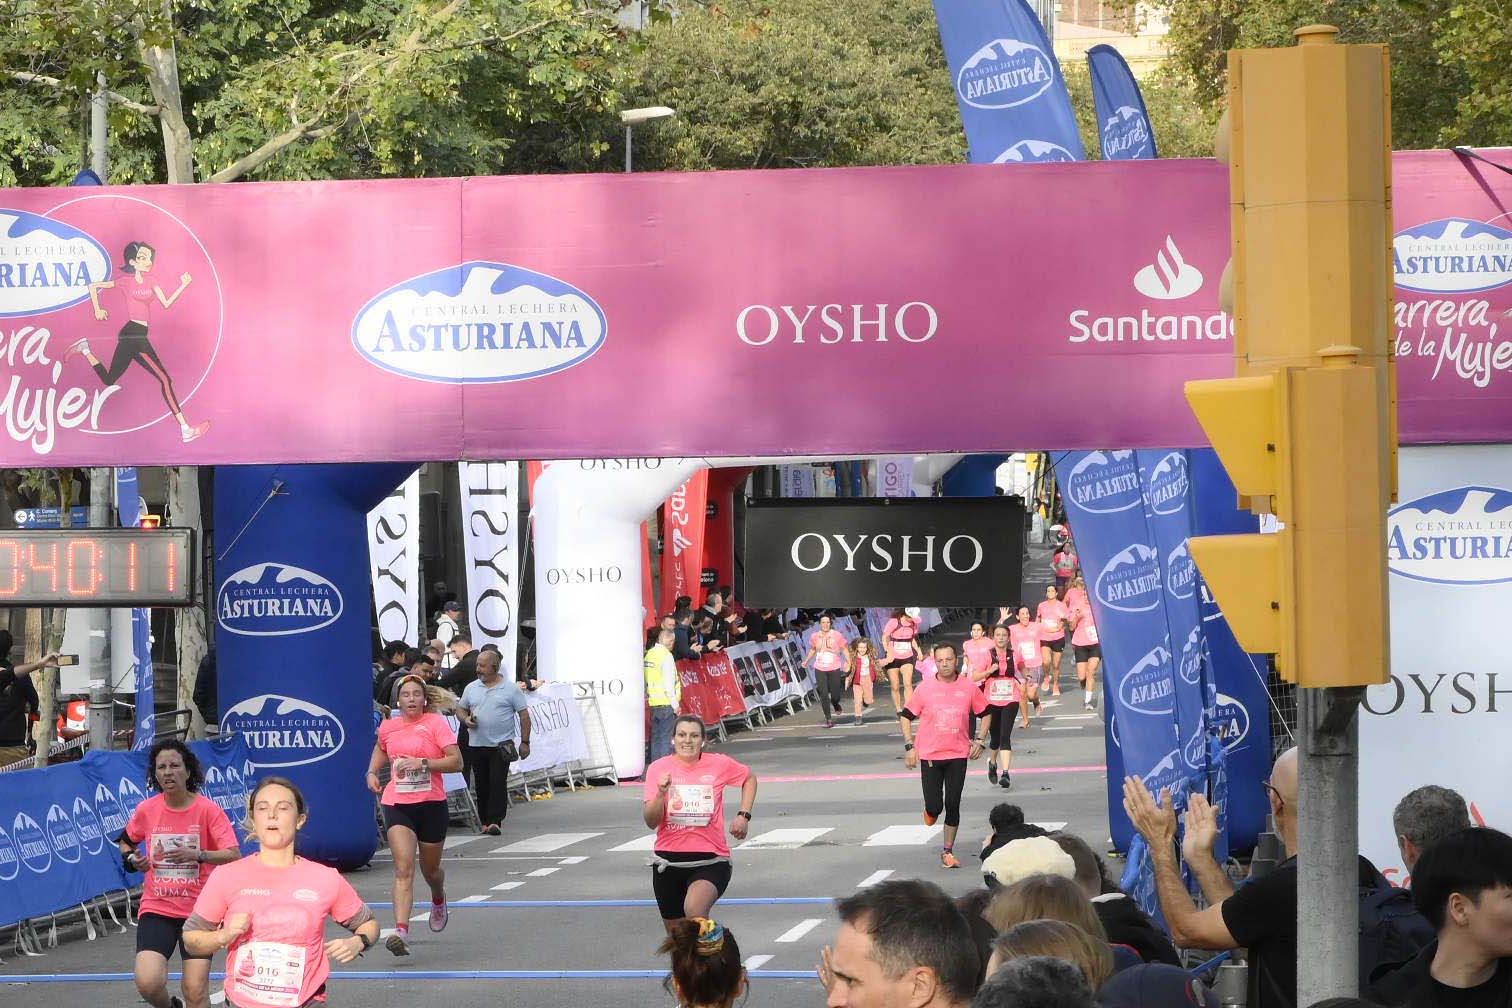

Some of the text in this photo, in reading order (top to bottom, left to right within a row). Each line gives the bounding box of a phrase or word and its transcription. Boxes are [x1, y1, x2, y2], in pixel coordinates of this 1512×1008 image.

[14, 245, 86, 256] LECHERA
[410, 302, 579, 317] CENTRAL LECHERA
[1393, 299, 1490, 328] arrera
[372, 309, 588, 353] ASTURIANA
[736, 301, 939, 346] OYSHO
[1417, 329, 1436, 357] la
[1415, 520, 1483, 531] CENTRAL
[790, 532, 984, 574] OYSHO
[546, 566, 622, 586] OYSHO
[233, 587, 329, 596] CENTRAL LECHERA
[221, 593, 334, 620] ASTURIANA
[235, 719, 330, 728] CENTRAL LECHERA
[243, 729, 336, 749] TURIANA
[153, 886, 189, 897] SUMA
